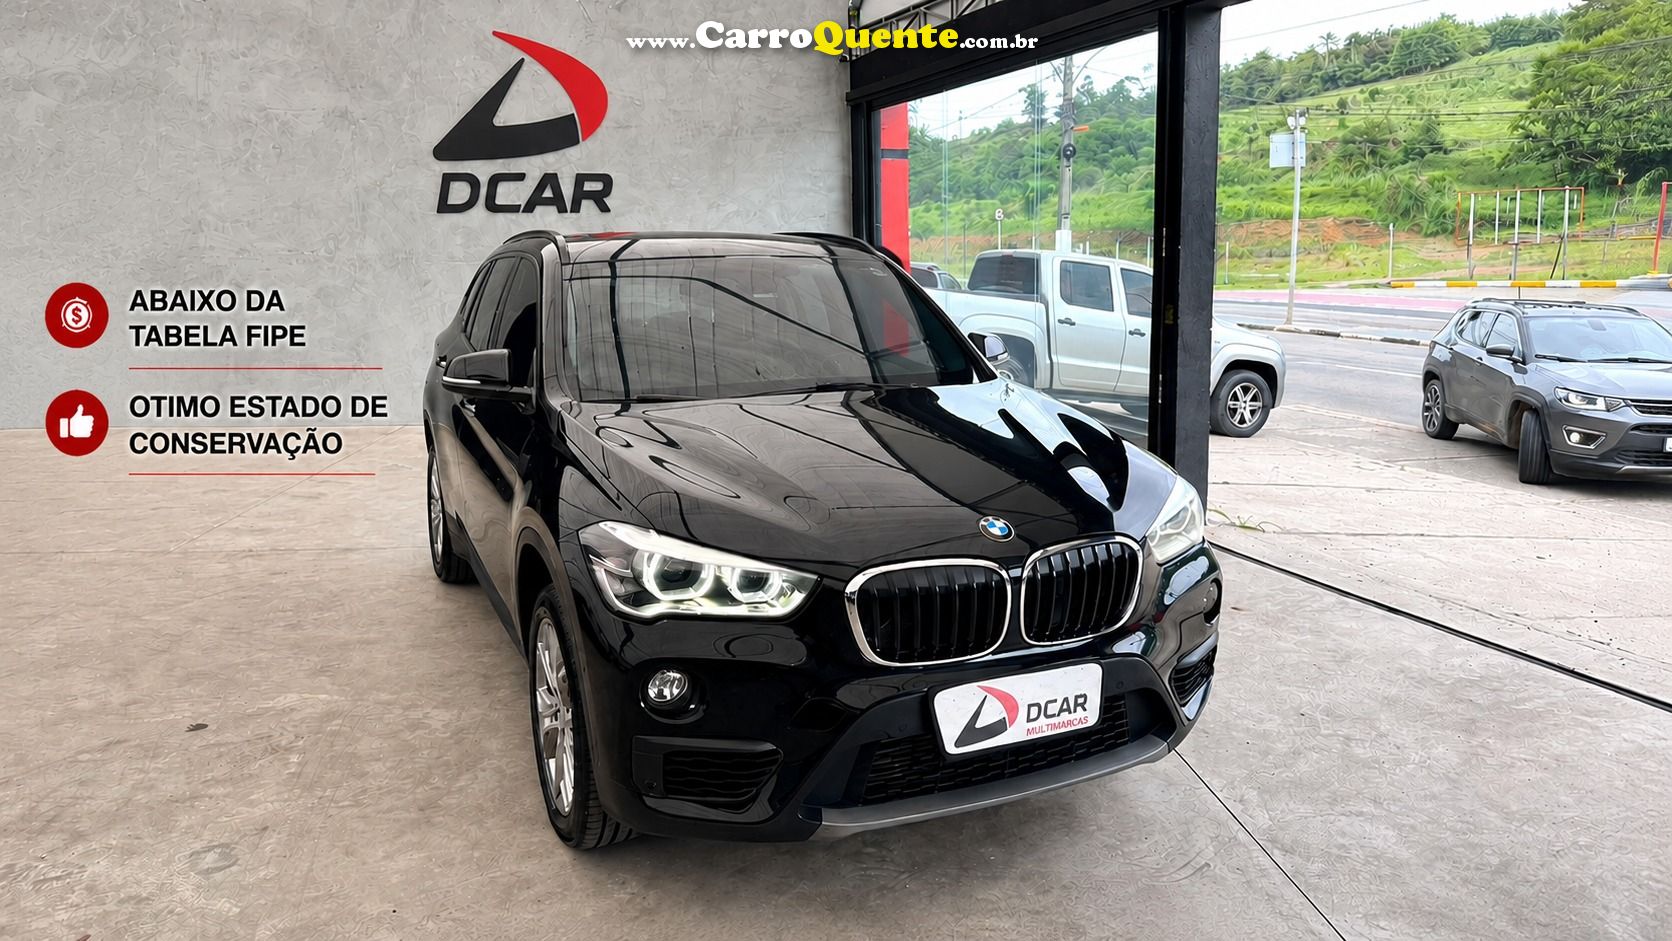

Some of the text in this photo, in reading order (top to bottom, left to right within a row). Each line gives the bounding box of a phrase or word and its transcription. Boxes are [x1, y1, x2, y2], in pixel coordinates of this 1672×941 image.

[436, 172, 614, 214] DCAR
[1026, 693, 1088, 723] DCAR
[1026, 717, 1089, 736] MULTIMARCAS
